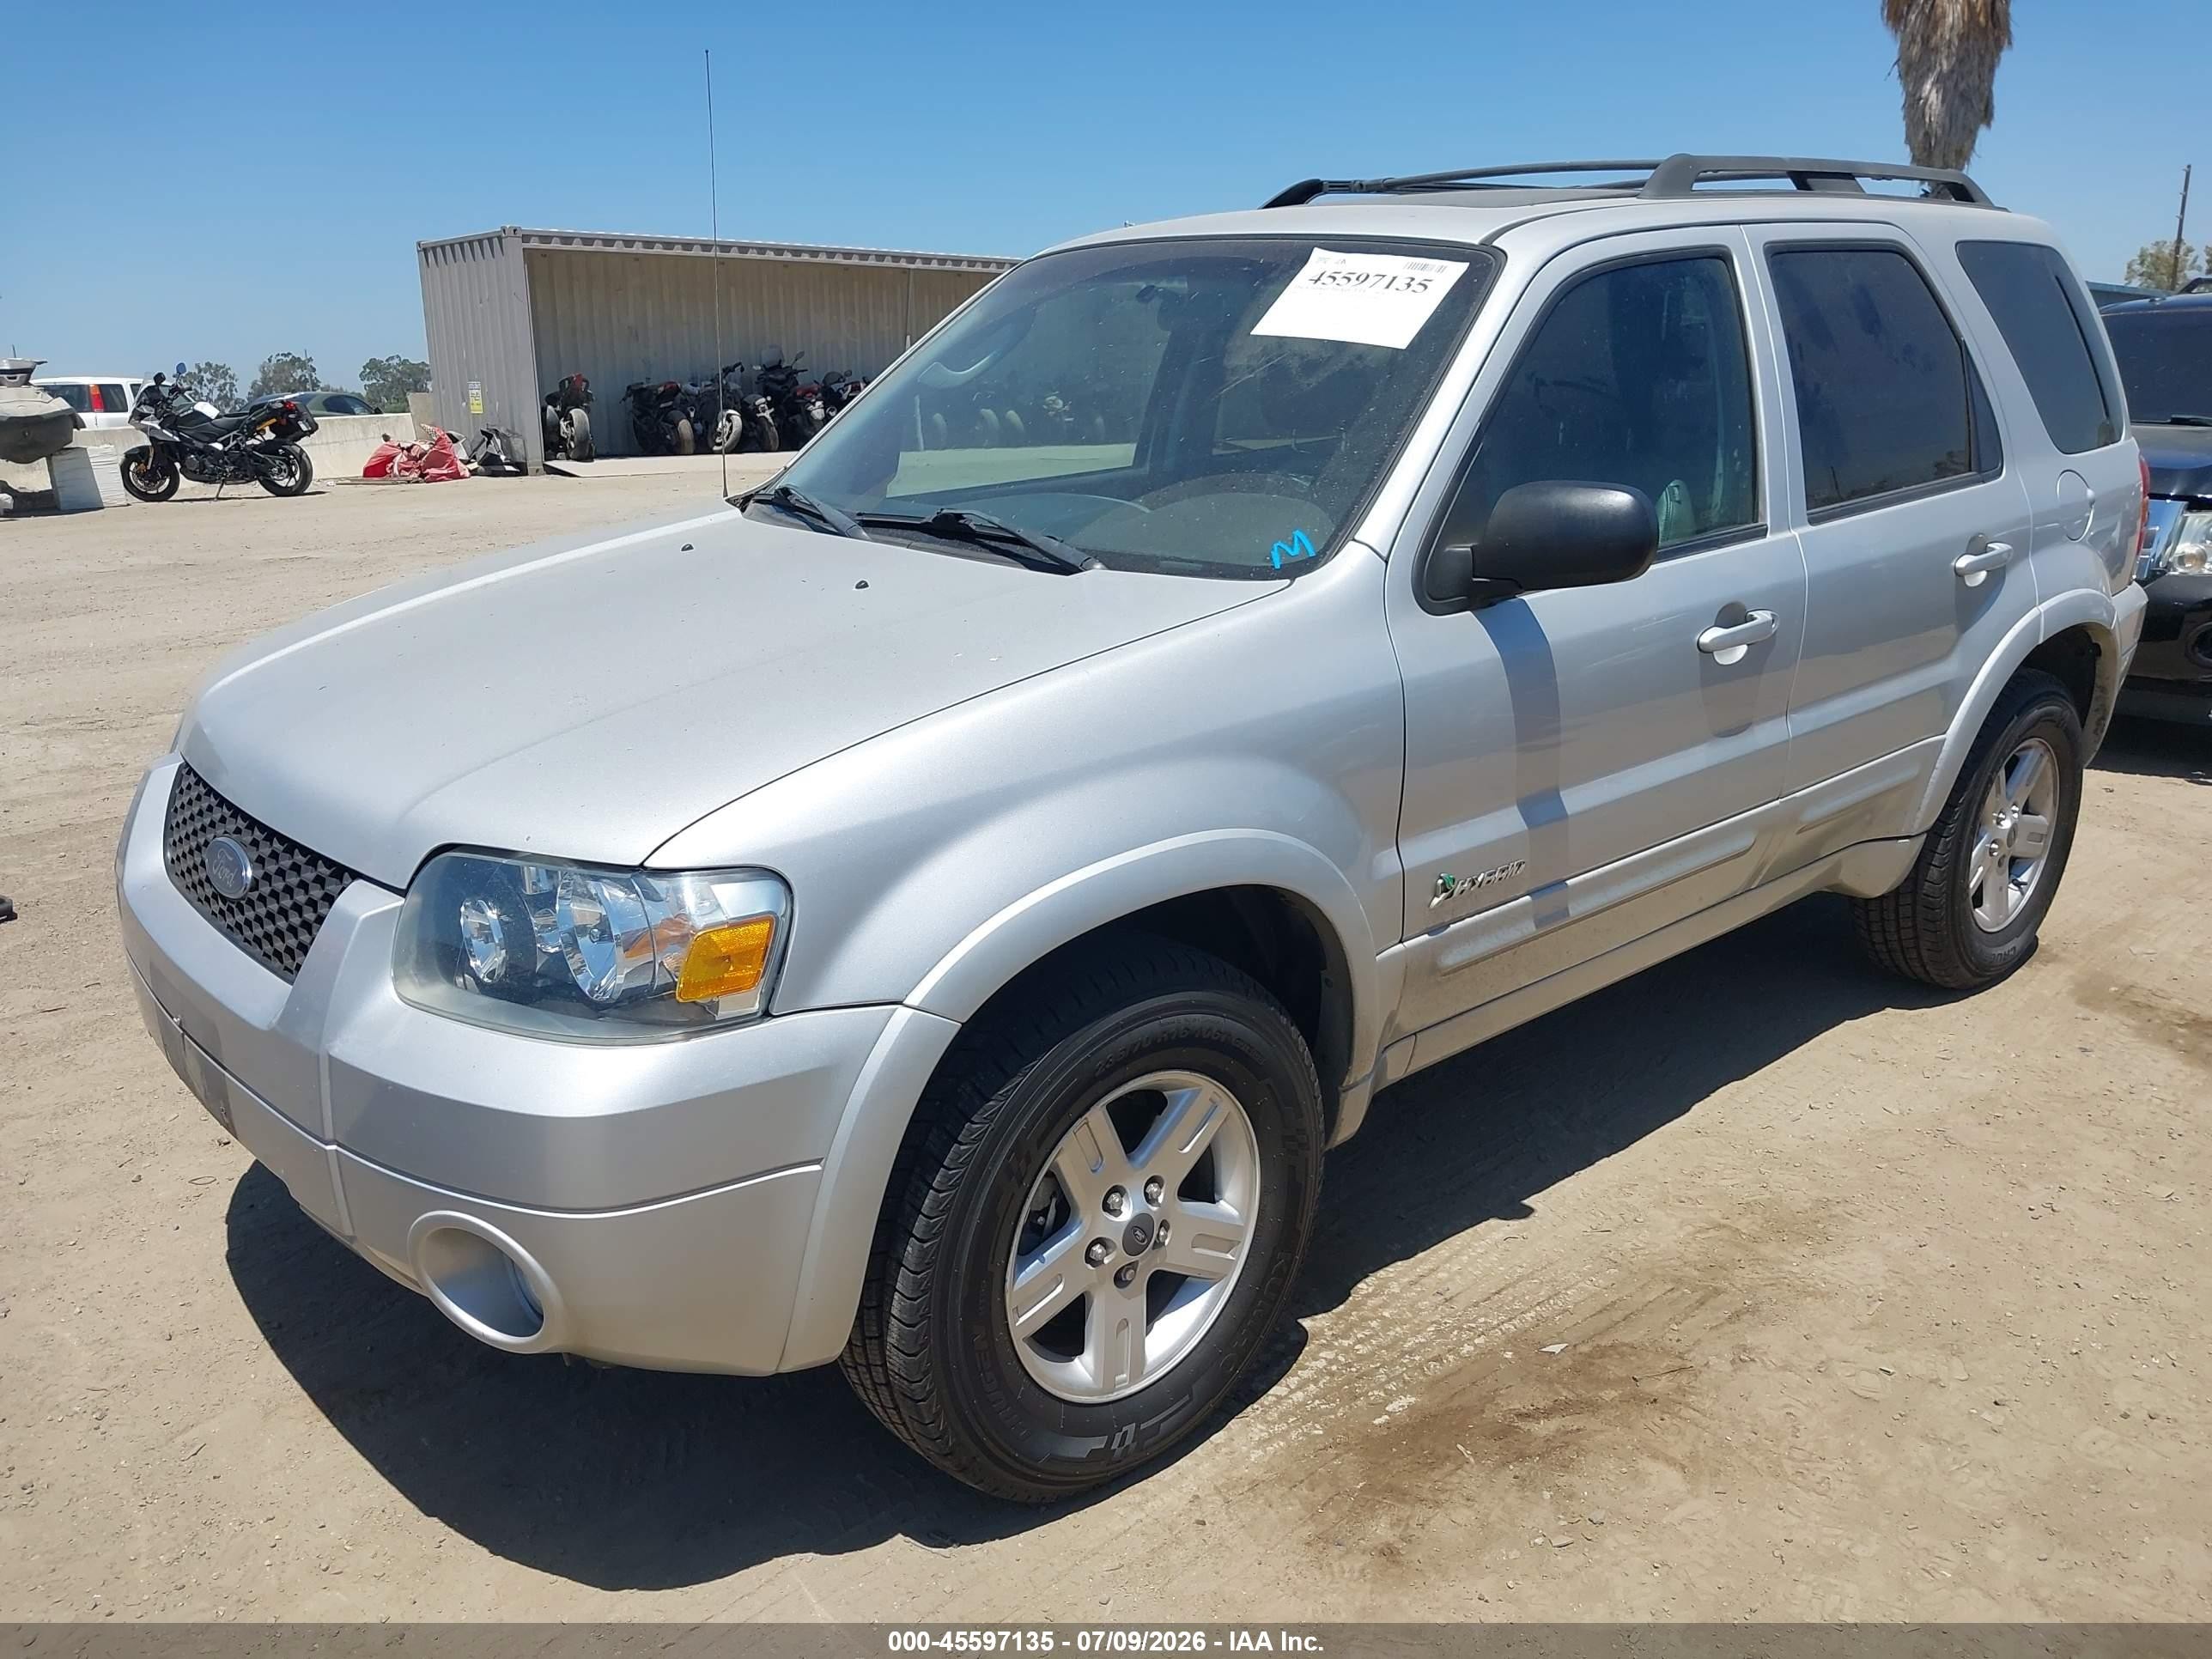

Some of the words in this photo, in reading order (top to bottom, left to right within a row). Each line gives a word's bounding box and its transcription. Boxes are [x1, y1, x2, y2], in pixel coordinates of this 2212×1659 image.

[1308, 270, 1433, 294] 45597135
[1271, 529, 1316, 568] M
[212, 848, 238, 888] Ford
